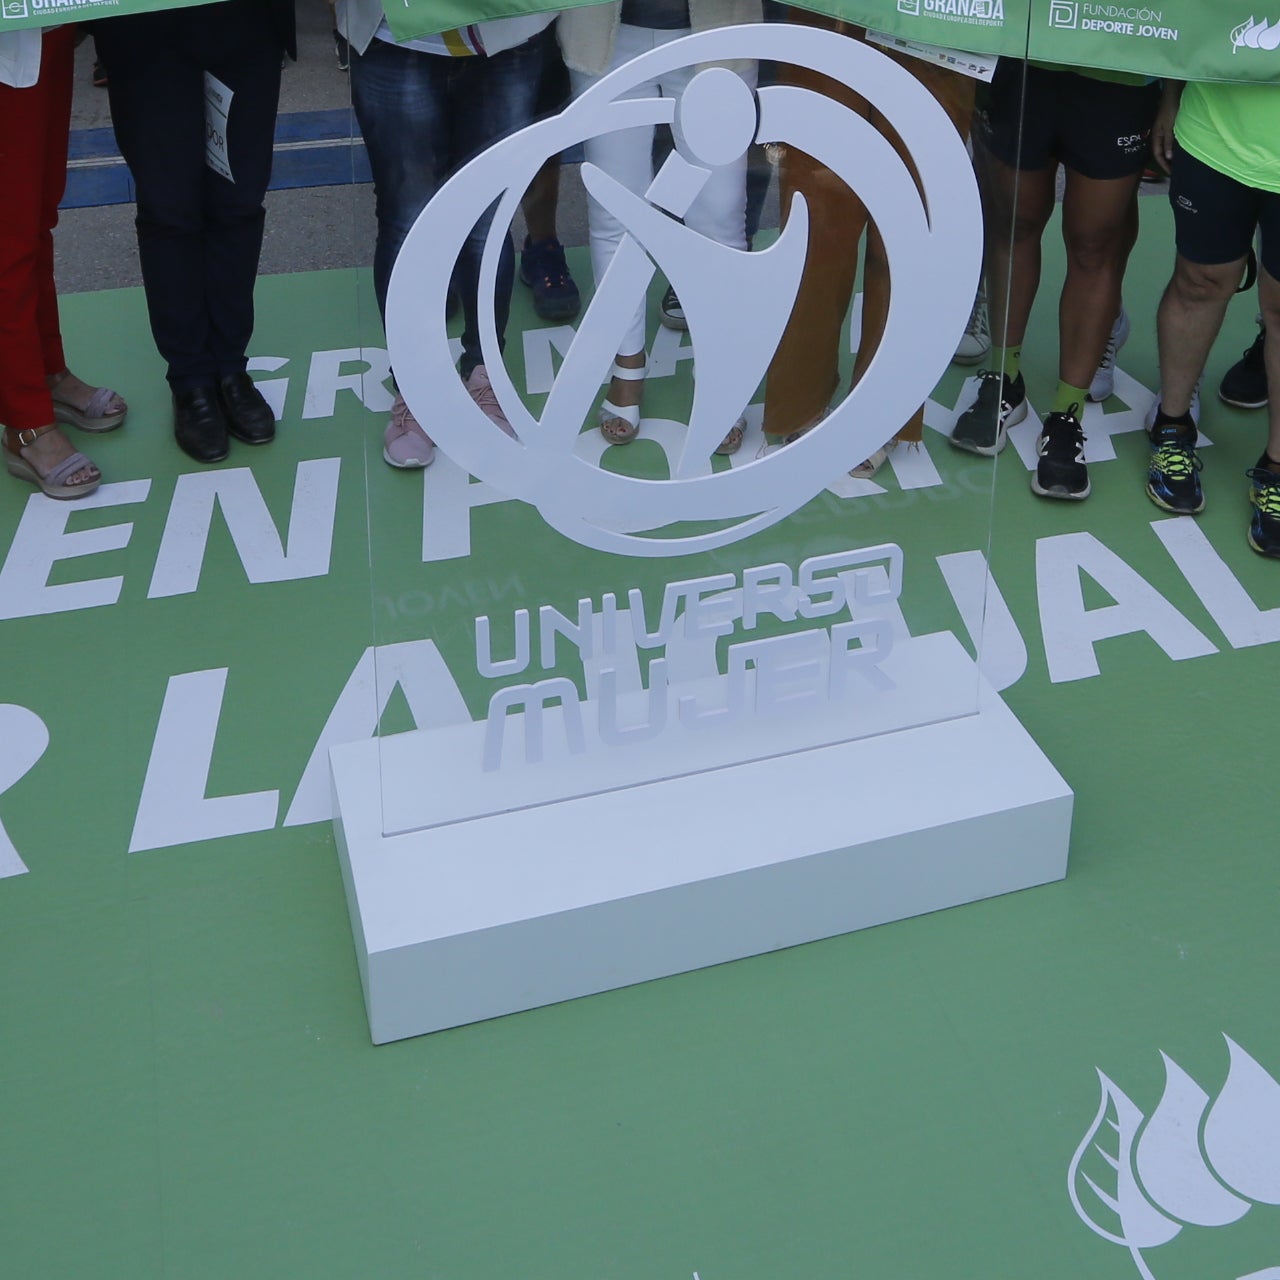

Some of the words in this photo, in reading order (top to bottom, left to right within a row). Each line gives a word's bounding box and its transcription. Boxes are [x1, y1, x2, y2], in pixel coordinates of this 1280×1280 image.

[1081, 19, 1134, 36] DEPORTE
[1136, 24, 1179, 41] JOVEN
[1083, 3, 1162, 23] FUNDACIÓN
[474, 542, 904, 679] UNIVERSO
[128, 638, 474, 853] LA
[482, 619, 898, 773] MUJER
